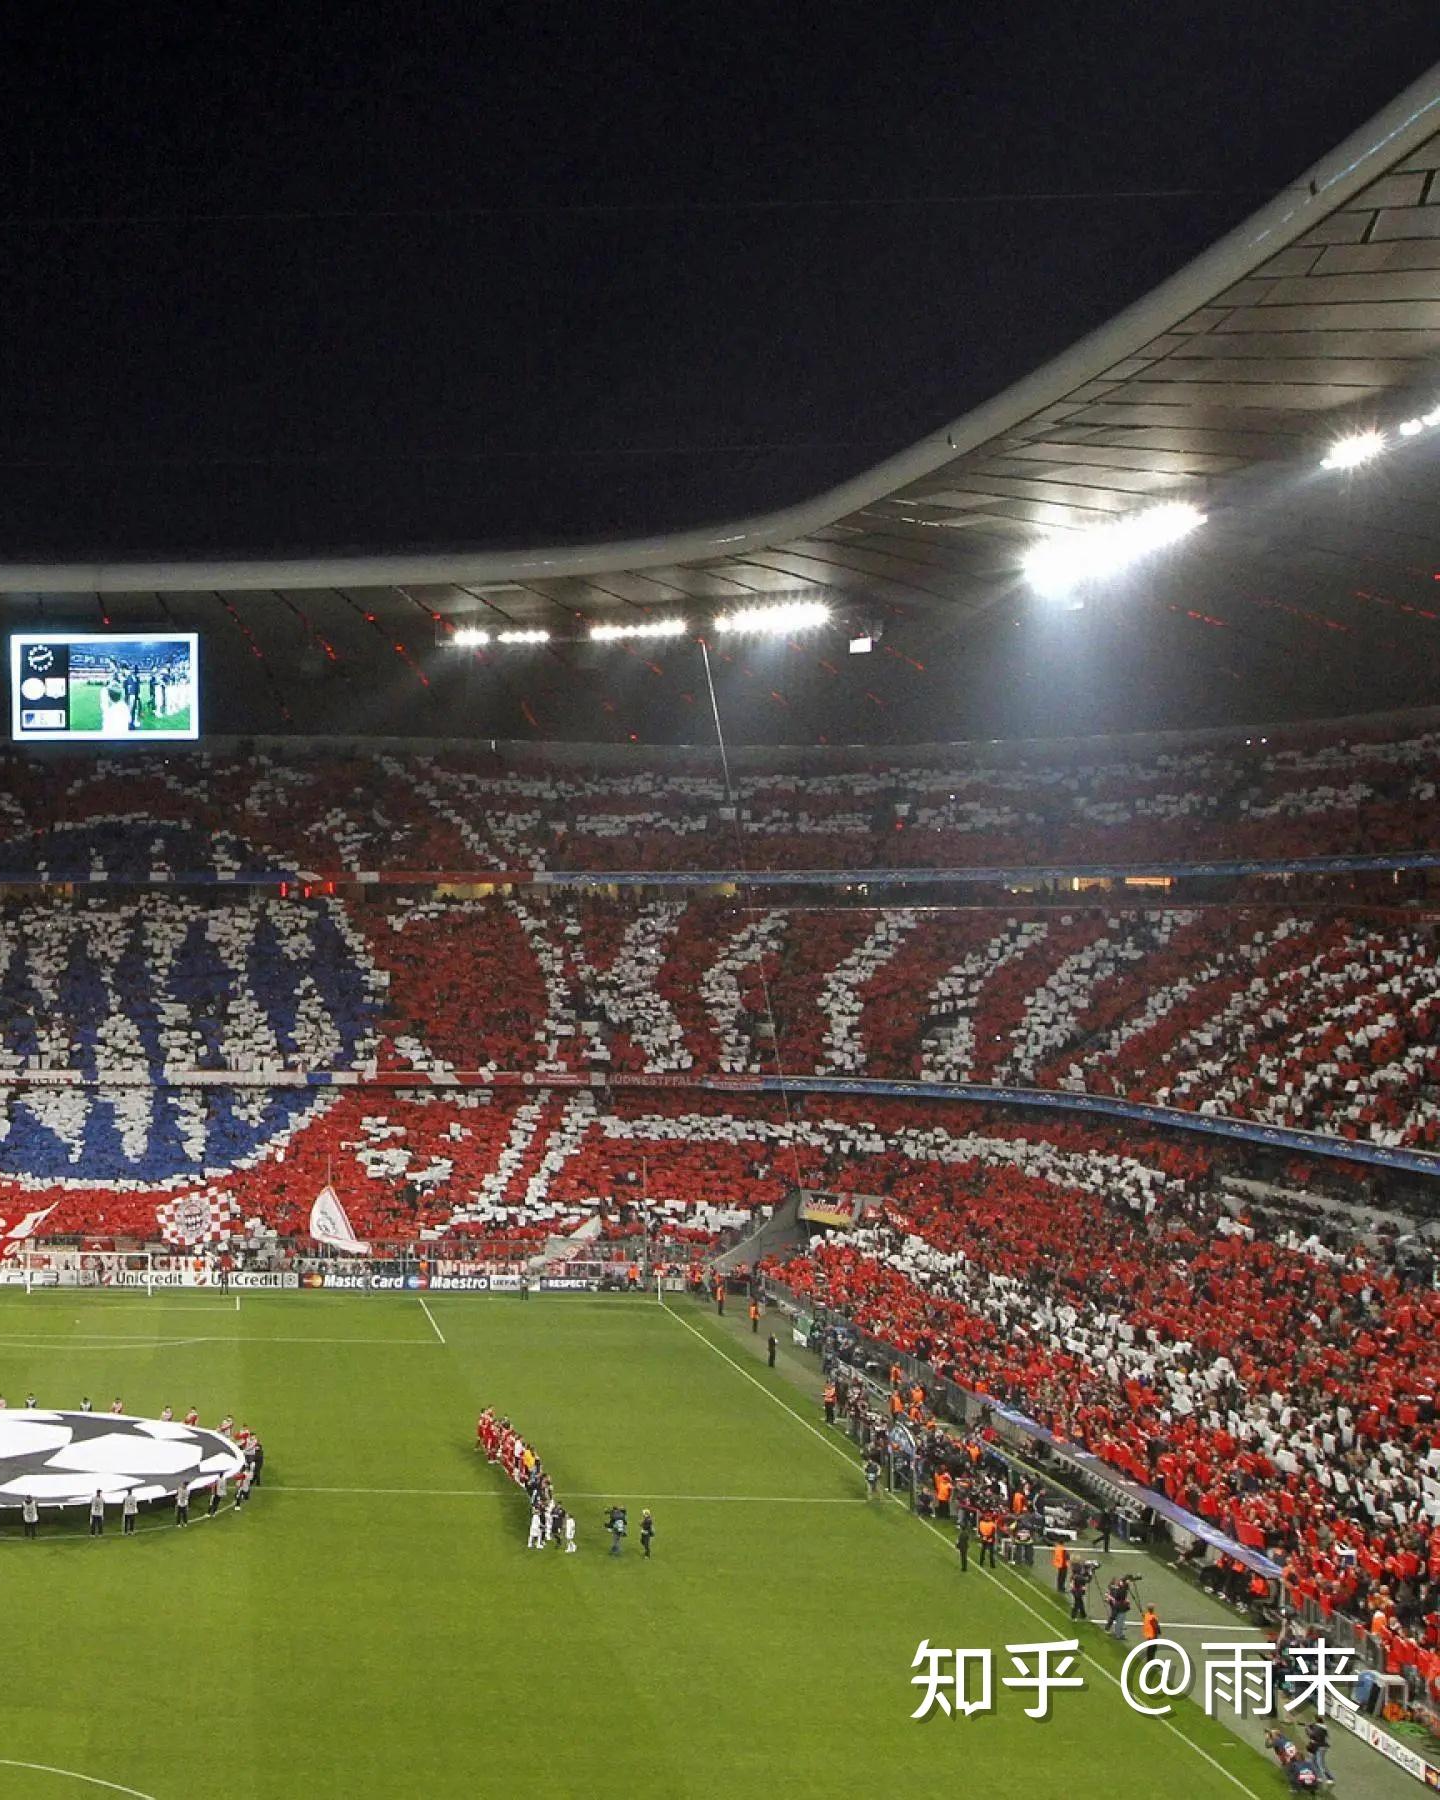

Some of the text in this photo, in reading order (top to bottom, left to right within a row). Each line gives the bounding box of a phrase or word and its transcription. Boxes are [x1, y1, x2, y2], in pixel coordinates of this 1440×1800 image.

[116, 1272, 182, 1285] UniCredit
[211, 1273, 278, 1286] UiCredit
[324, 1275, 404, 1289] MasteCard
[430, 1276, 487, 1289] Maestro
[549, 1279, 587, 1288] RESPECT
